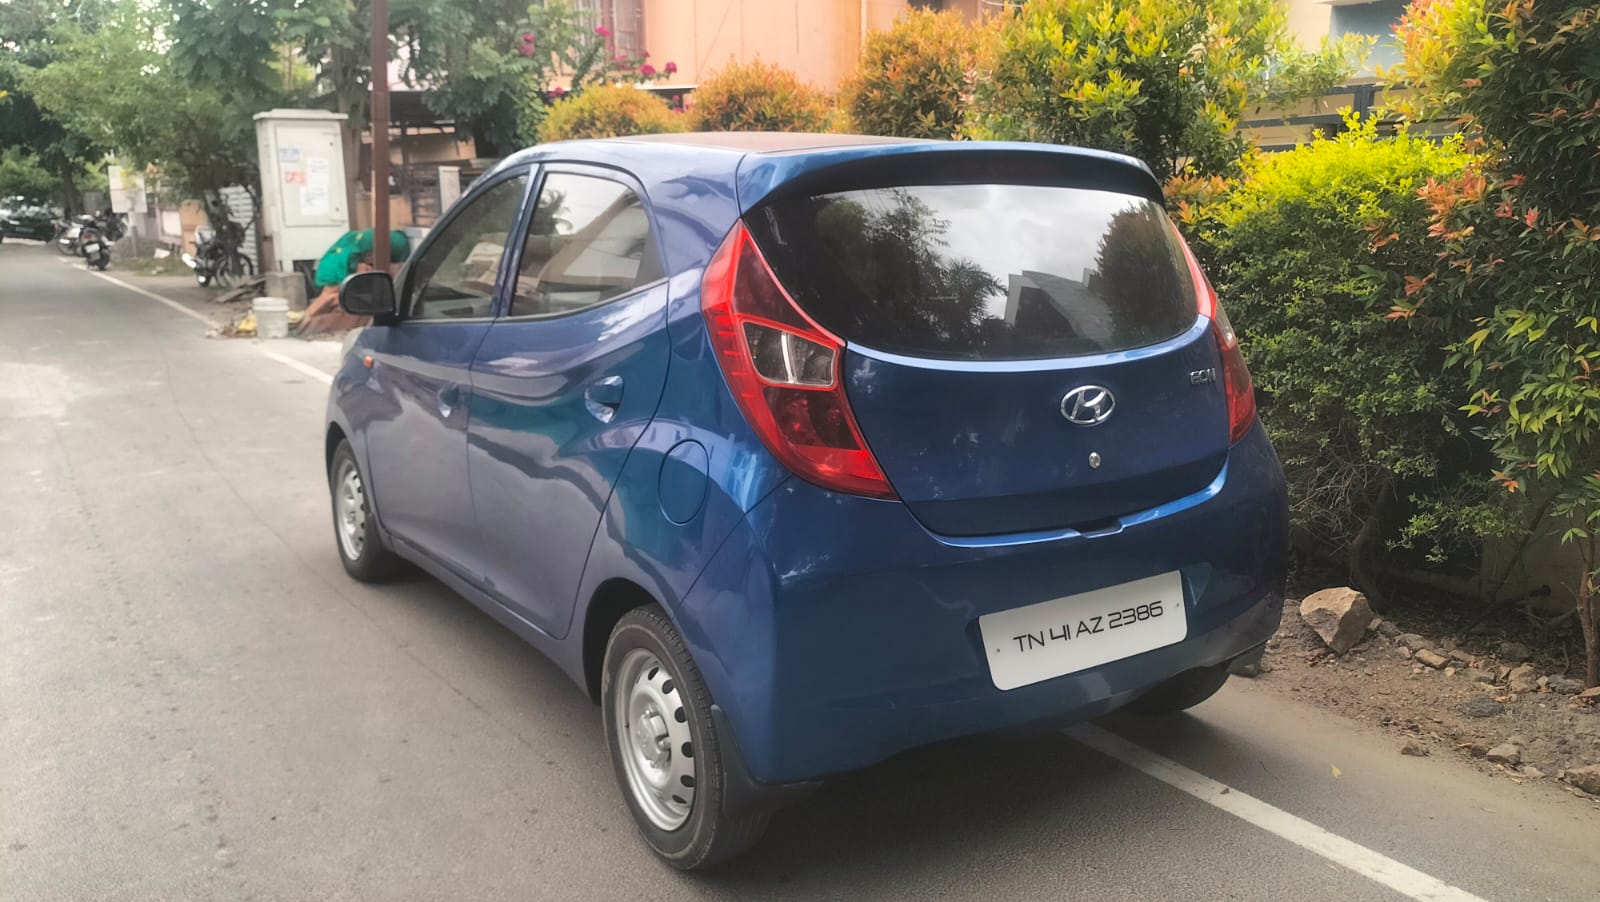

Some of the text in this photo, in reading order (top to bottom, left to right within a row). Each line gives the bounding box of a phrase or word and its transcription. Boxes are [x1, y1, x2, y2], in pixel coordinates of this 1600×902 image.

[1013, 600, 1164, 652] TN 41 AZ 2386
